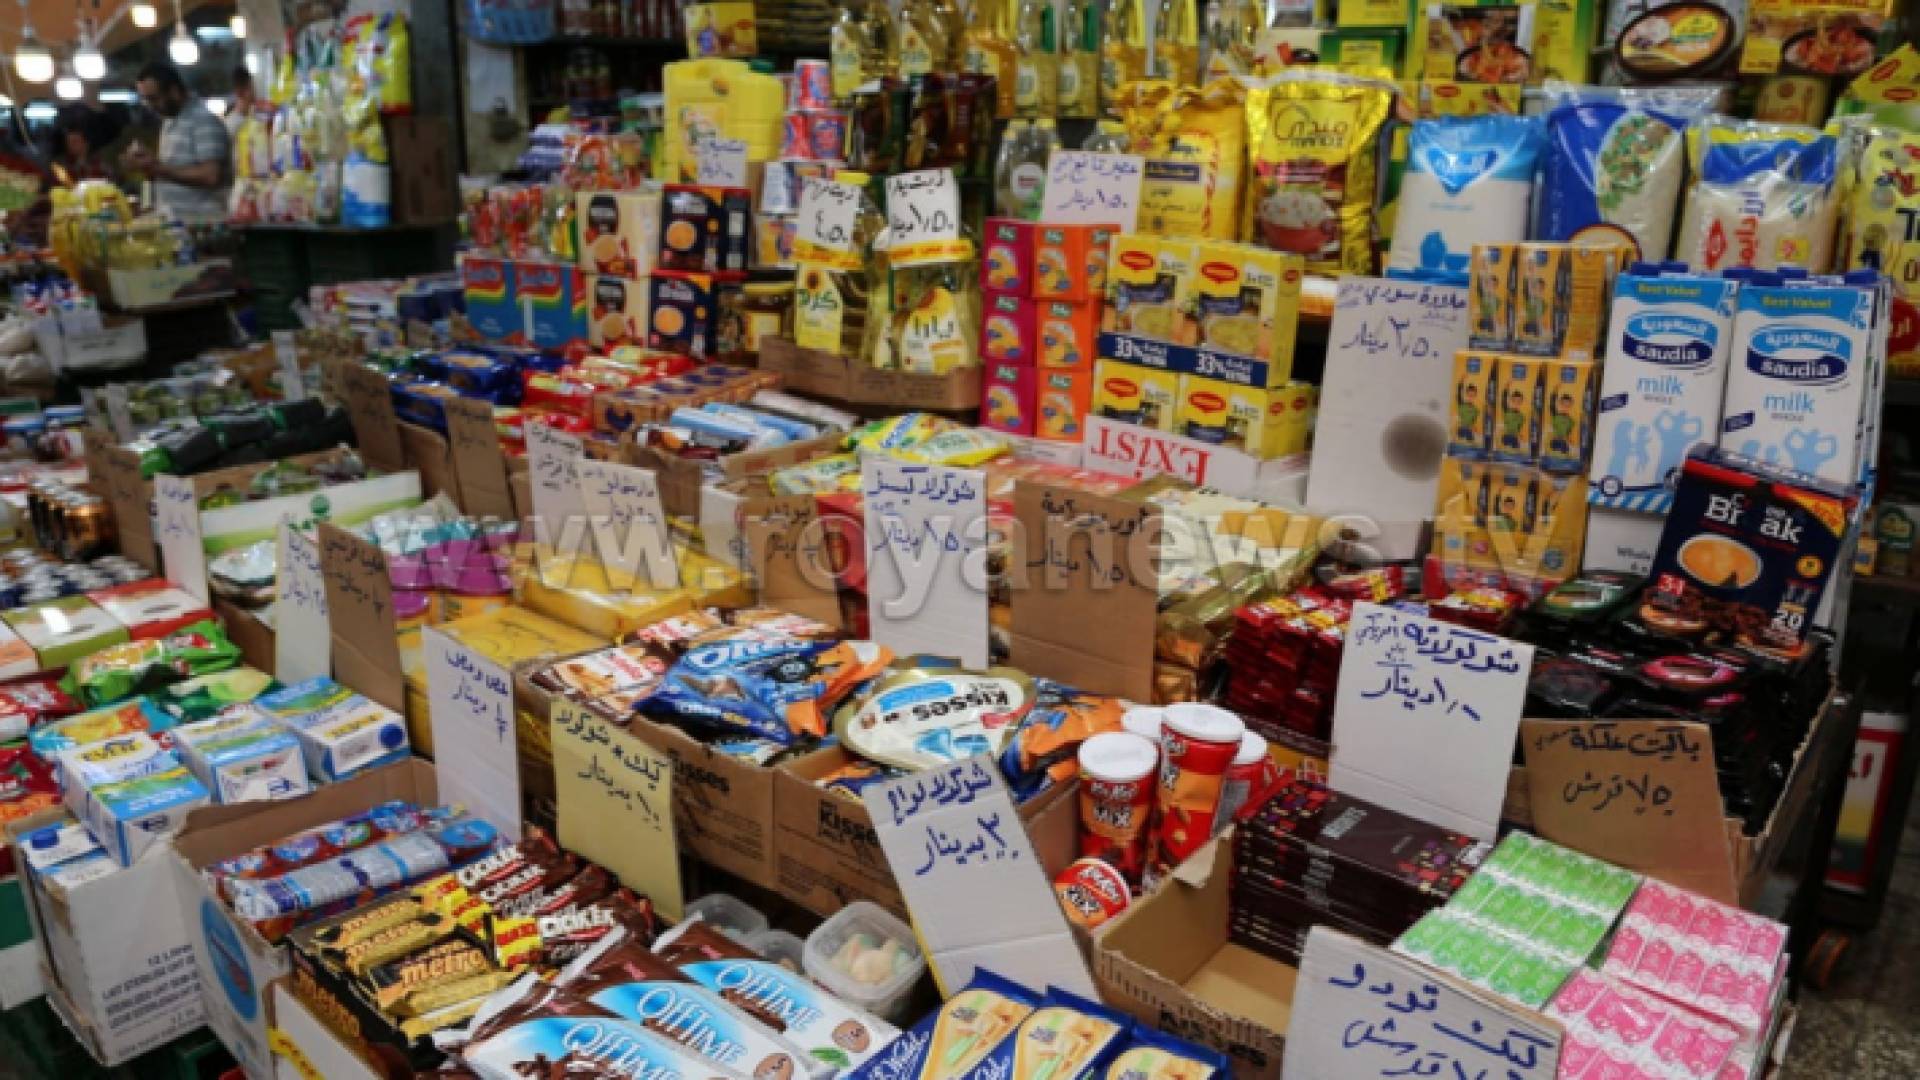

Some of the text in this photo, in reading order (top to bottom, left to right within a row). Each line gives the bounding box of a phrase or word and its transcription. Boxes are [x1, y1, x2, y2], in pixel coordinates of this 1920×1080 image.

[1635, 344, 1700, 361] saudia
[1761, 359, 1830, 377] saudia
[1637, 375, 1684, 396] milk
[1763, 392, 1816, 413] milk
